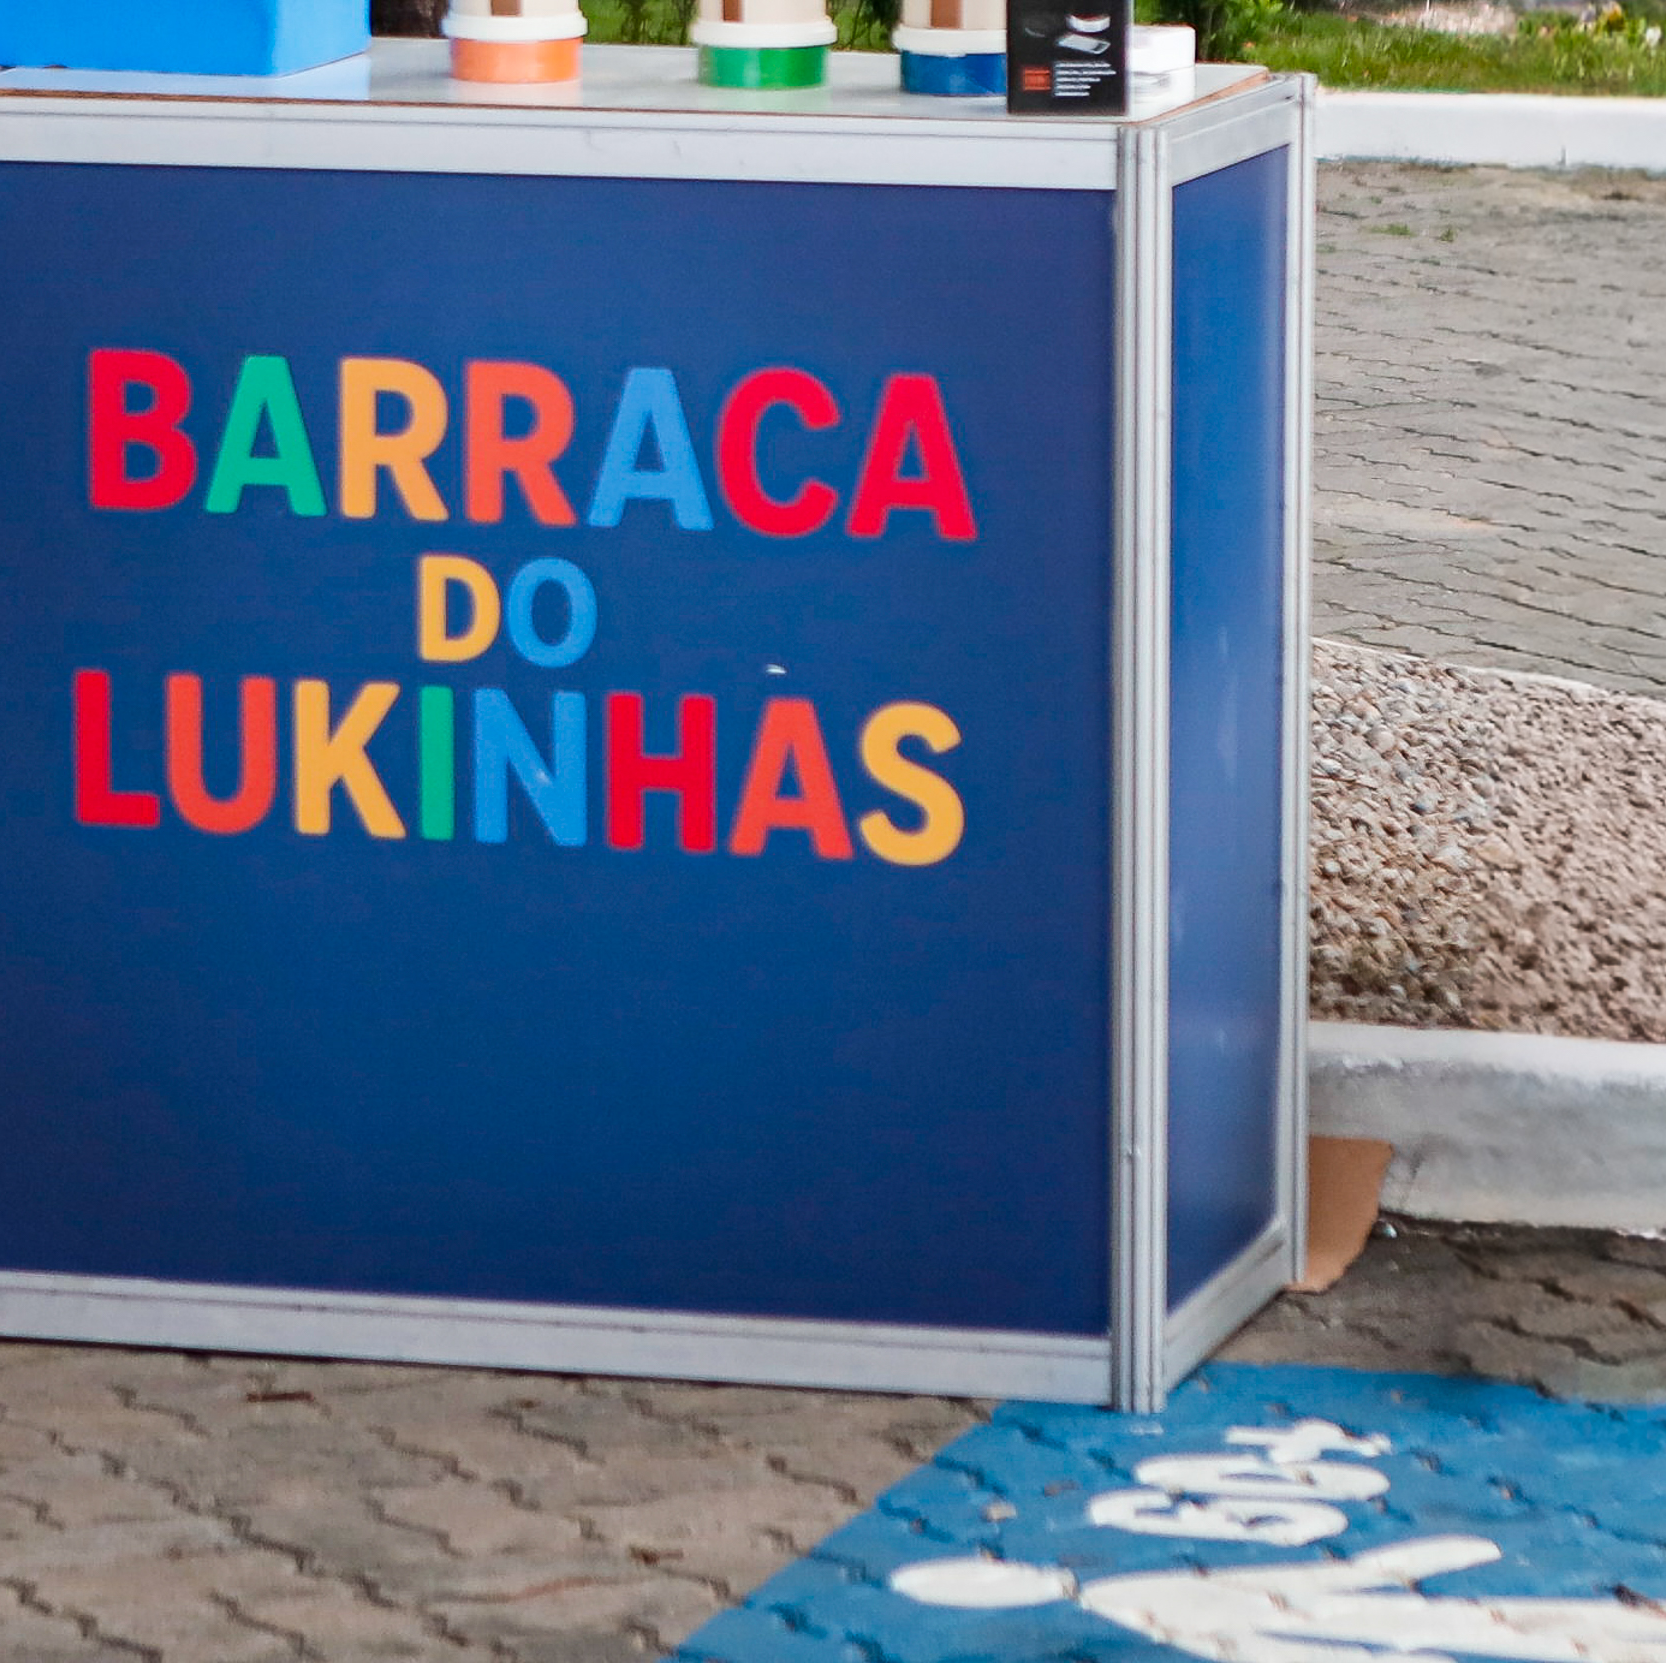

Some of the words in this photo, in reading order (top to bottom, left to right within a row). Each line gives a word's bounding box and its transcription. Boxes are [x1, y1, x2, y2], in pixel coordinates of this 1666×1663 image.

[88, 347, 978, 542] BARRACA
[417, 553, 599, 668] DO
[74, 667, 966, 867] LUKINHAS
